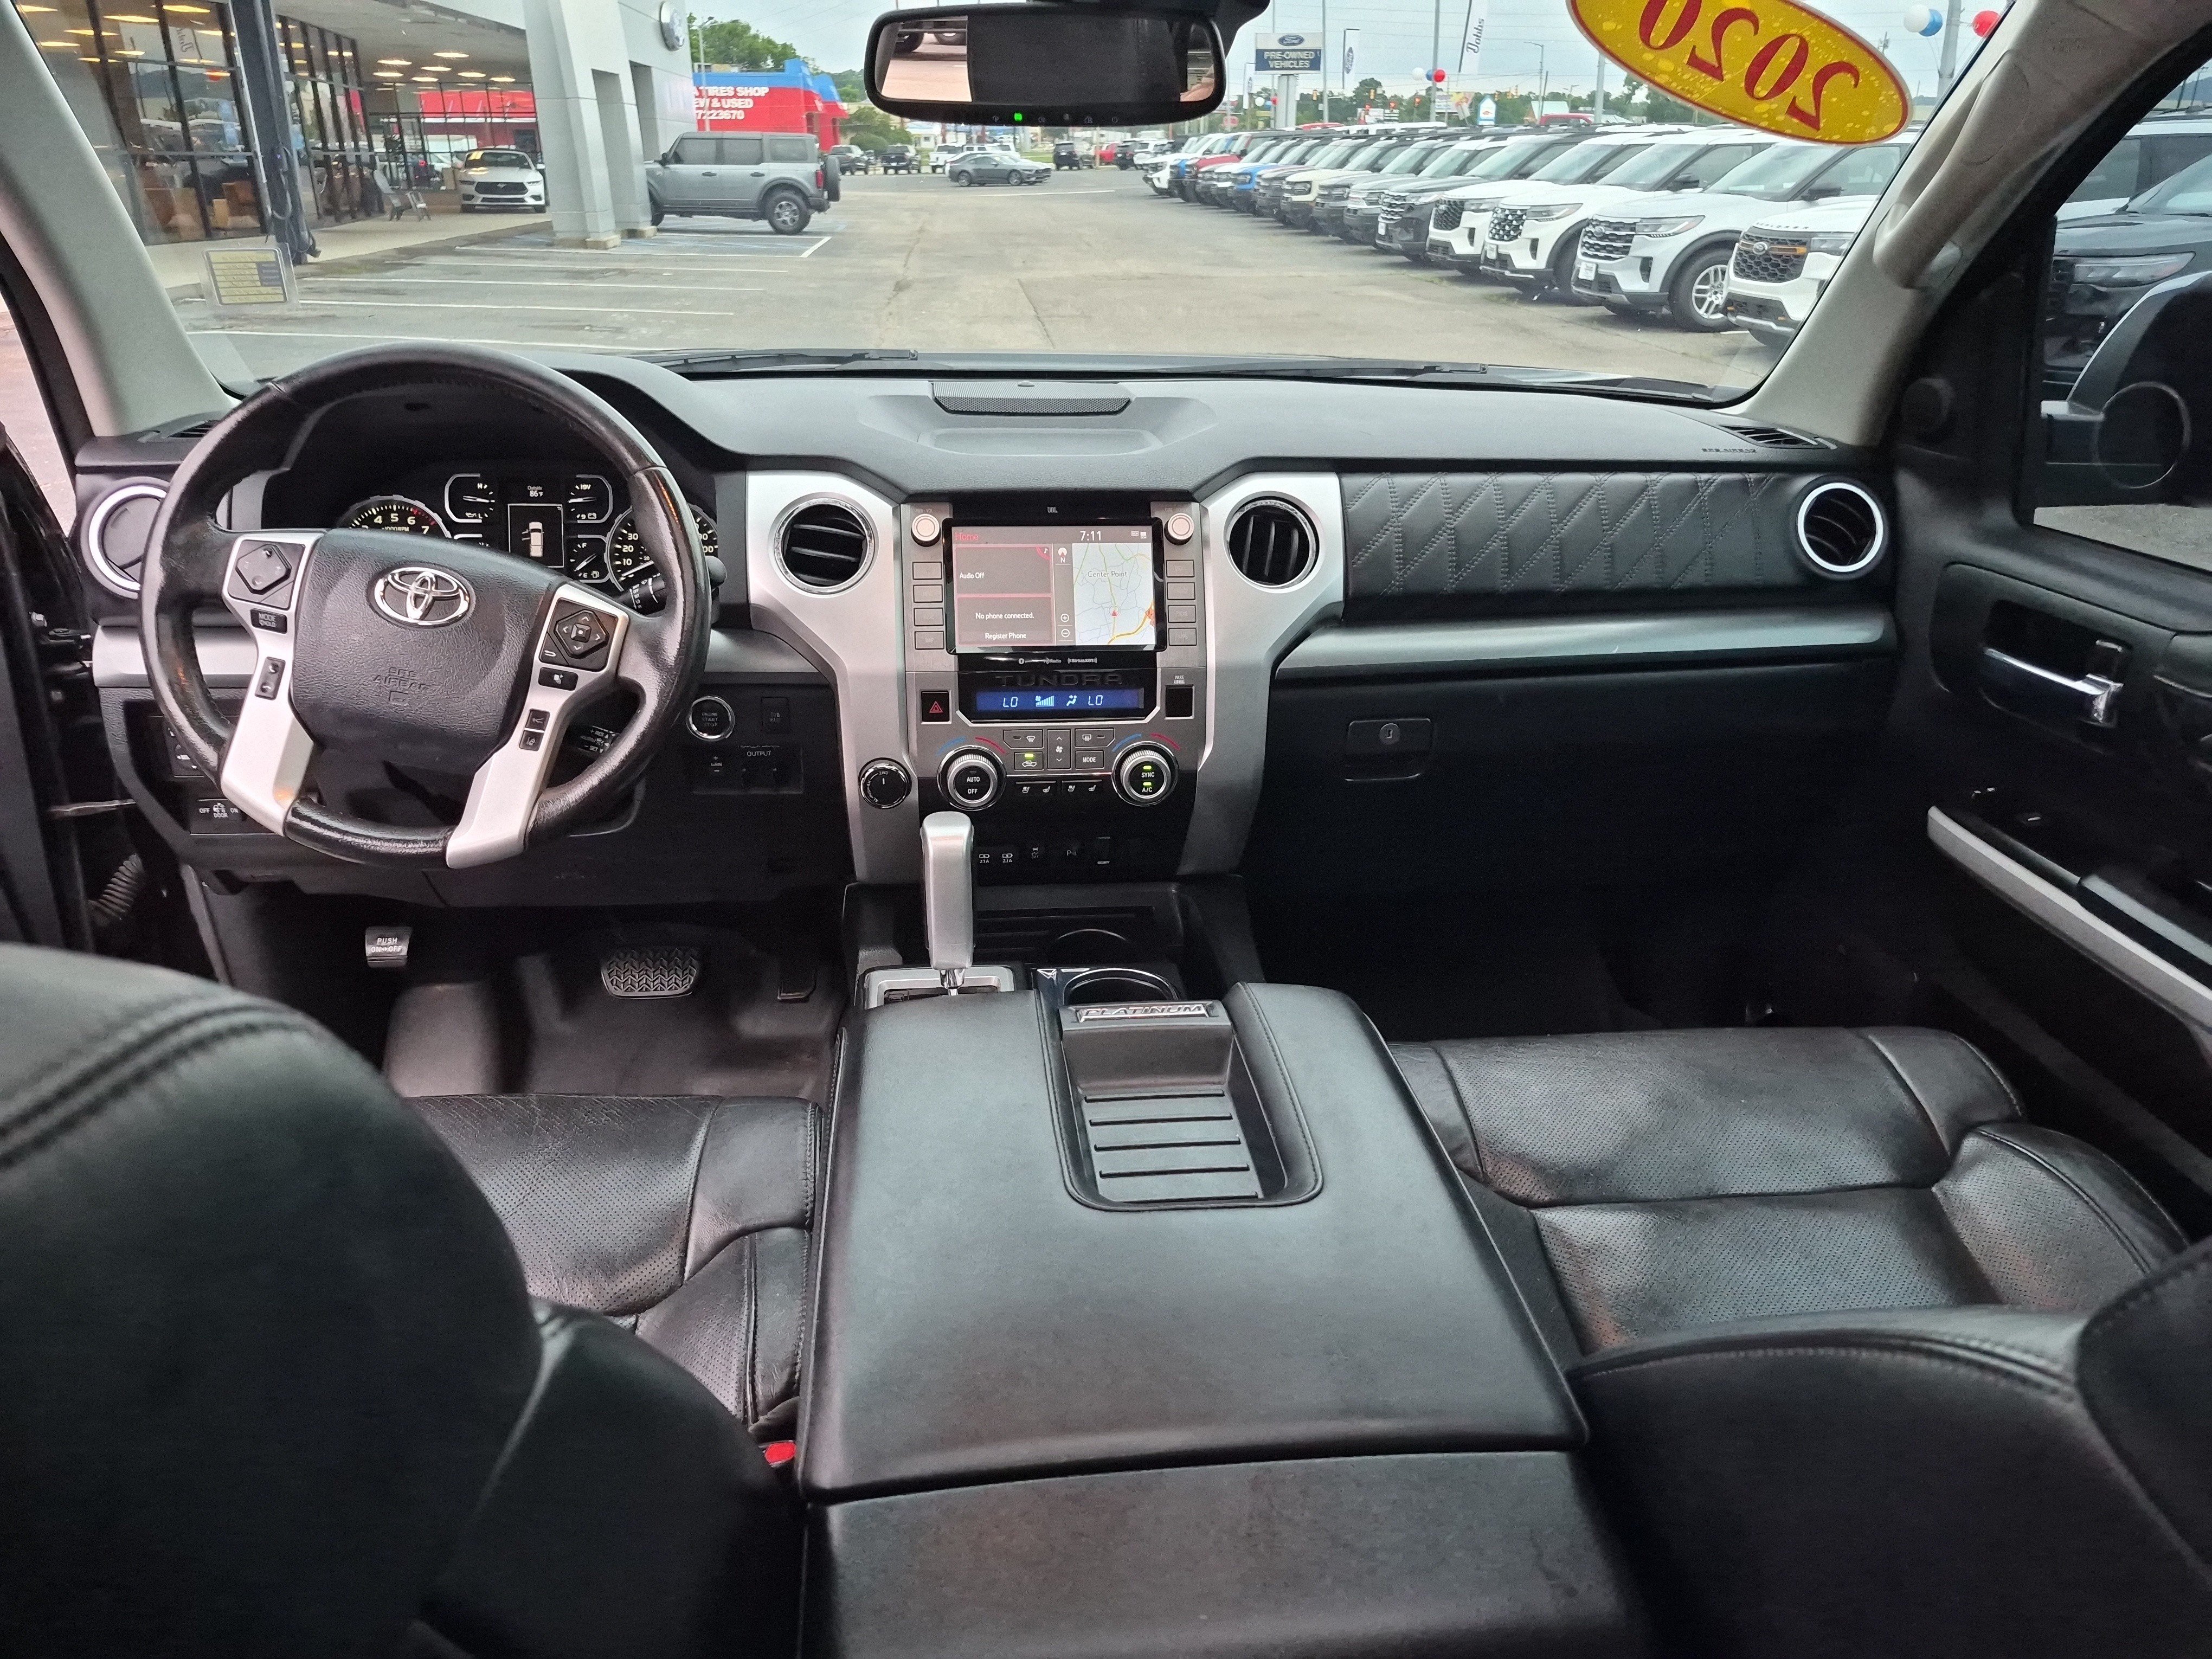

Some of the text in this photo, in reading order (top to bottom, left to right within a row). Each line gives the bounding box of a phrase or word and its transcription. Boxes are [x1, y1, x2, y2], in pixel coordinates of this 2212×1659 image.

[1466, 18, 1484, 54] Dobbs
[1264, 51, 1315, 59] PRE-OWNED
[1269, 60, 1311, 68] VEHICLES
[736, 86, 769, 97] SHOP
[710, 98, 721, 108] &
[722, 98, 754, 108] USED
[374, 513, 429, 535] 4 5 6 7
[627, 532, 639, 541] 30
[955, 532, 979, 541] Home
[1079, 530, 1101, 542] 7:11
[259, 613, 276, 622] MODE
[985, 612, 1003, 620] phone
[985, 632, 1008, 640] Register
[994, 674, 1122, 687] TUNDRA
[1002, 696, 1018, 708] LO
[1088, 695, 1103, 706] LO
[377, 937, 398, 945] PUSH
[1084, 1004, 1203, 1016] PLATINUM
